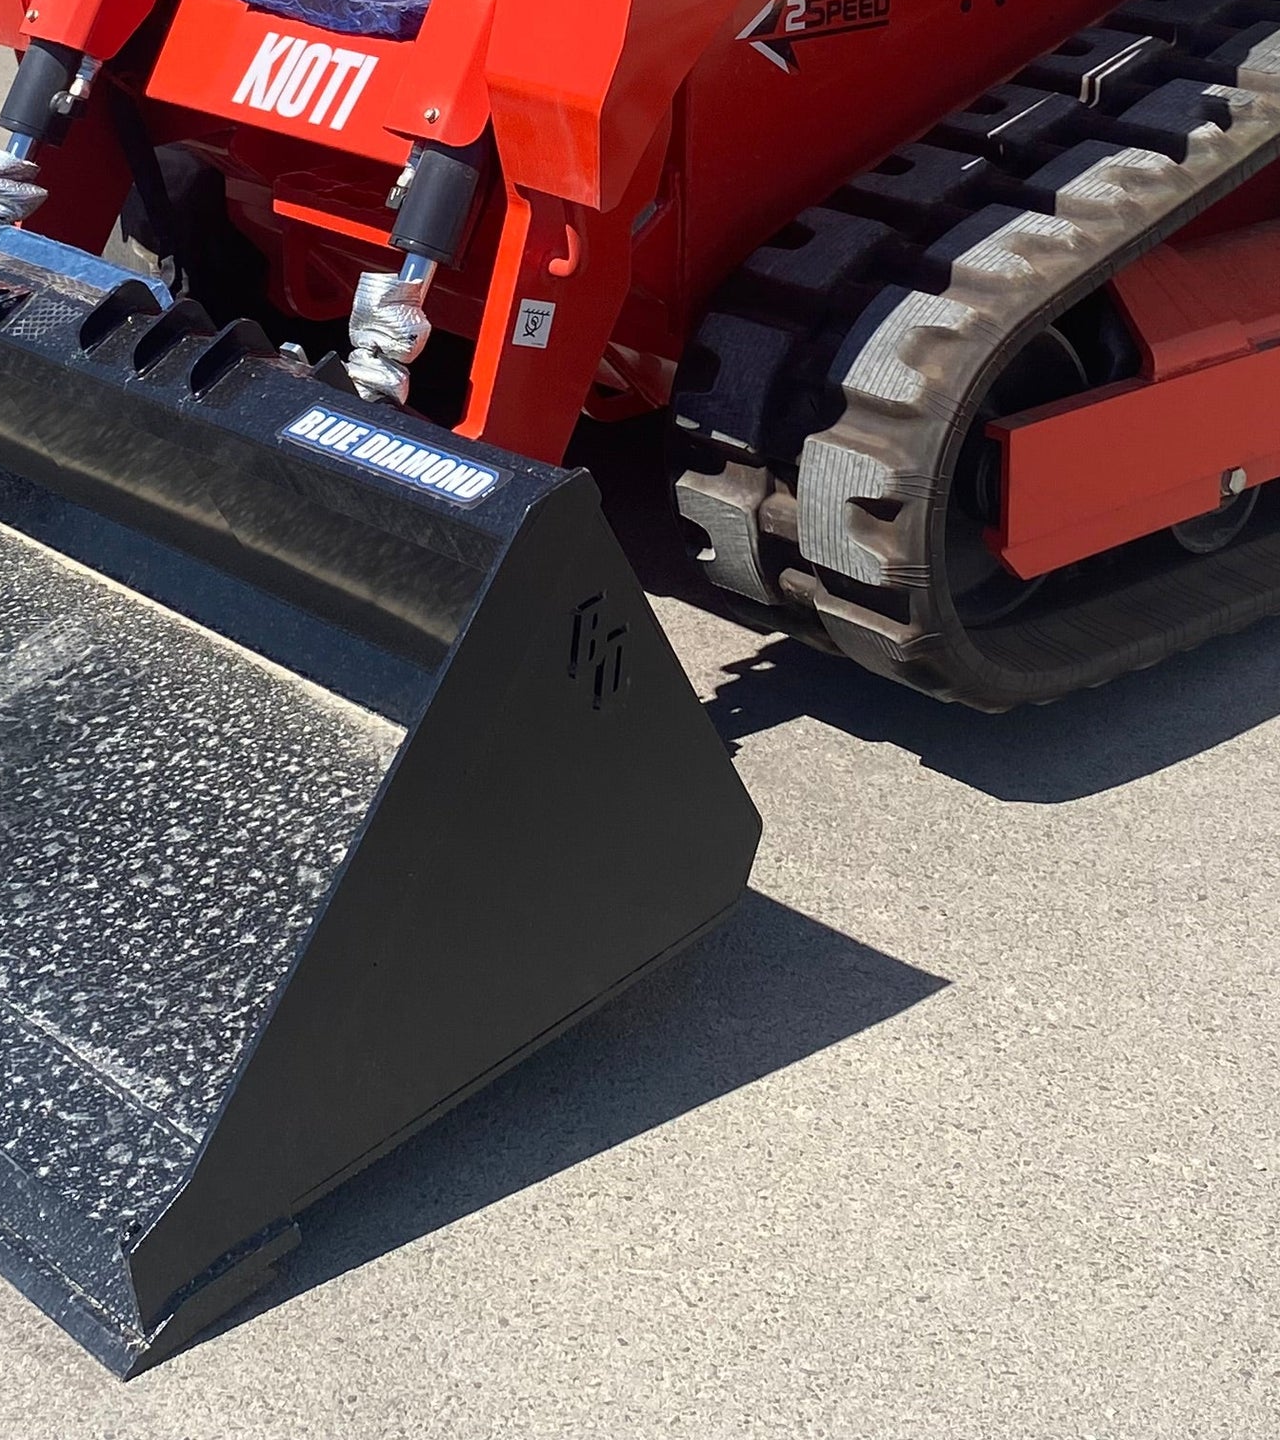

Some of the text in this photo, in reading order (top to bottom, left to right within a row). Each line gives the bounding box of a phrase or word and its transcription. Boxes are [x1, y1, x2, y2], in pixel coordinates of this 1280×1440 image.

[231, 31, 380, 131] KIOTI
[288, 410, 495, 498] BLUE DIAMOND
